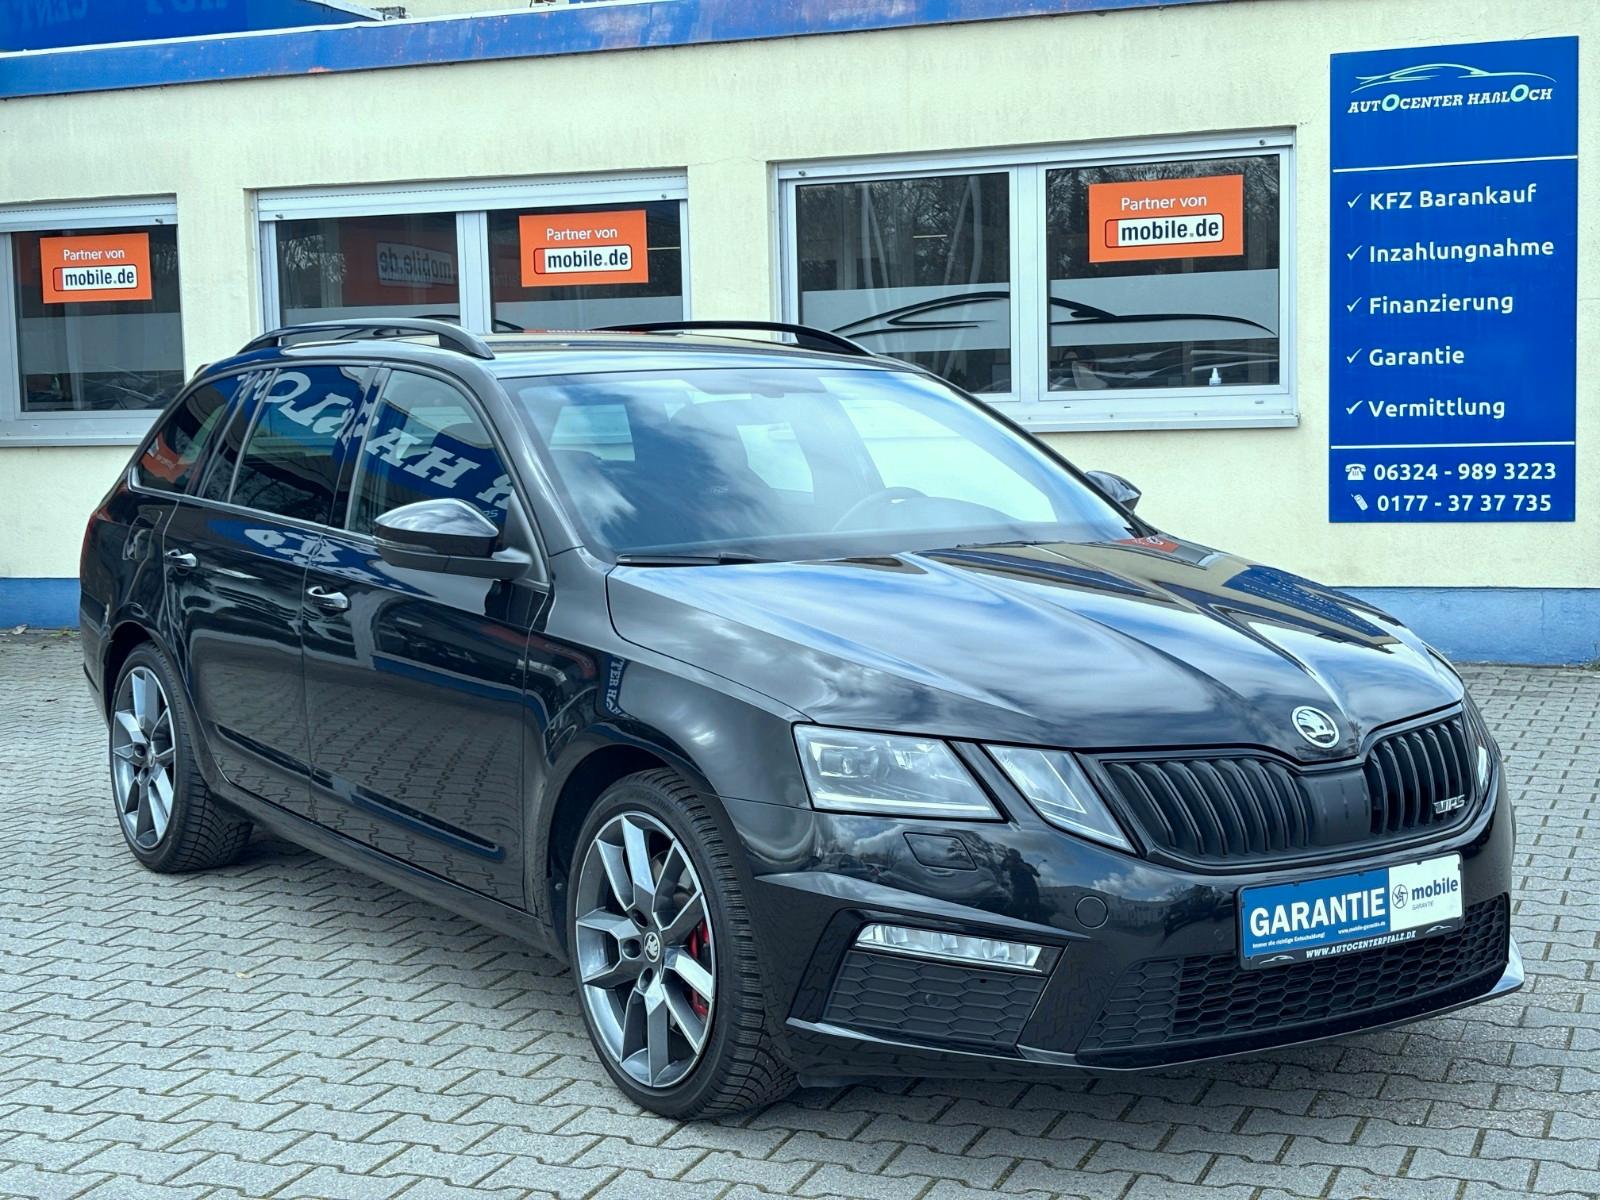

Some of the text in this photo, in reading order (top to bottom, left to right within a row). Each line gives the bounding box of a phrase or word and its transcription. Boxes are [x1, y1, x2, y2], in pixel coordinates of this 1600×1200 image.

[1347, 93, 1463, 114] AUTOCENTER
[1121, 196, 1207, 211] Partner von
[1370, 183, 1537, 210] KFZ Barankauf
[546, 228, 618, 241] Partner von
[1121, 218, 1219, 241] mobile.de
[63, 249, 125, 261] Partner von
[547, 249, 629, 269] mobile.de
[1369, 237, 1554, 262] Inzahlungnahme
[65, 268, 135, 286] mobile.de
[1369, 293, 1513, 314] Finanzierung
[1368, 346, 1465, 366] Garantie
[1368, 397, 1505, 419] Vermittlung
[1373, 464, 1437, 481] 06324
[1457, 463, 1497, 480] 989
[1503, 462, 1556, 480] 3223
[1377, 495, 1428, 512] 0177
[1448, 495, 1473, 512] 37
[1480, 495, 1505, 512] 37
[1513, 494, 1551, 511] 735
[1411, 876, 1459, 901] mobile
[1250, 887, 1386, 937] GARANTIE
[1305, 930, 1417, 959] WWW.AUTOCENTERPFALZ.DE
